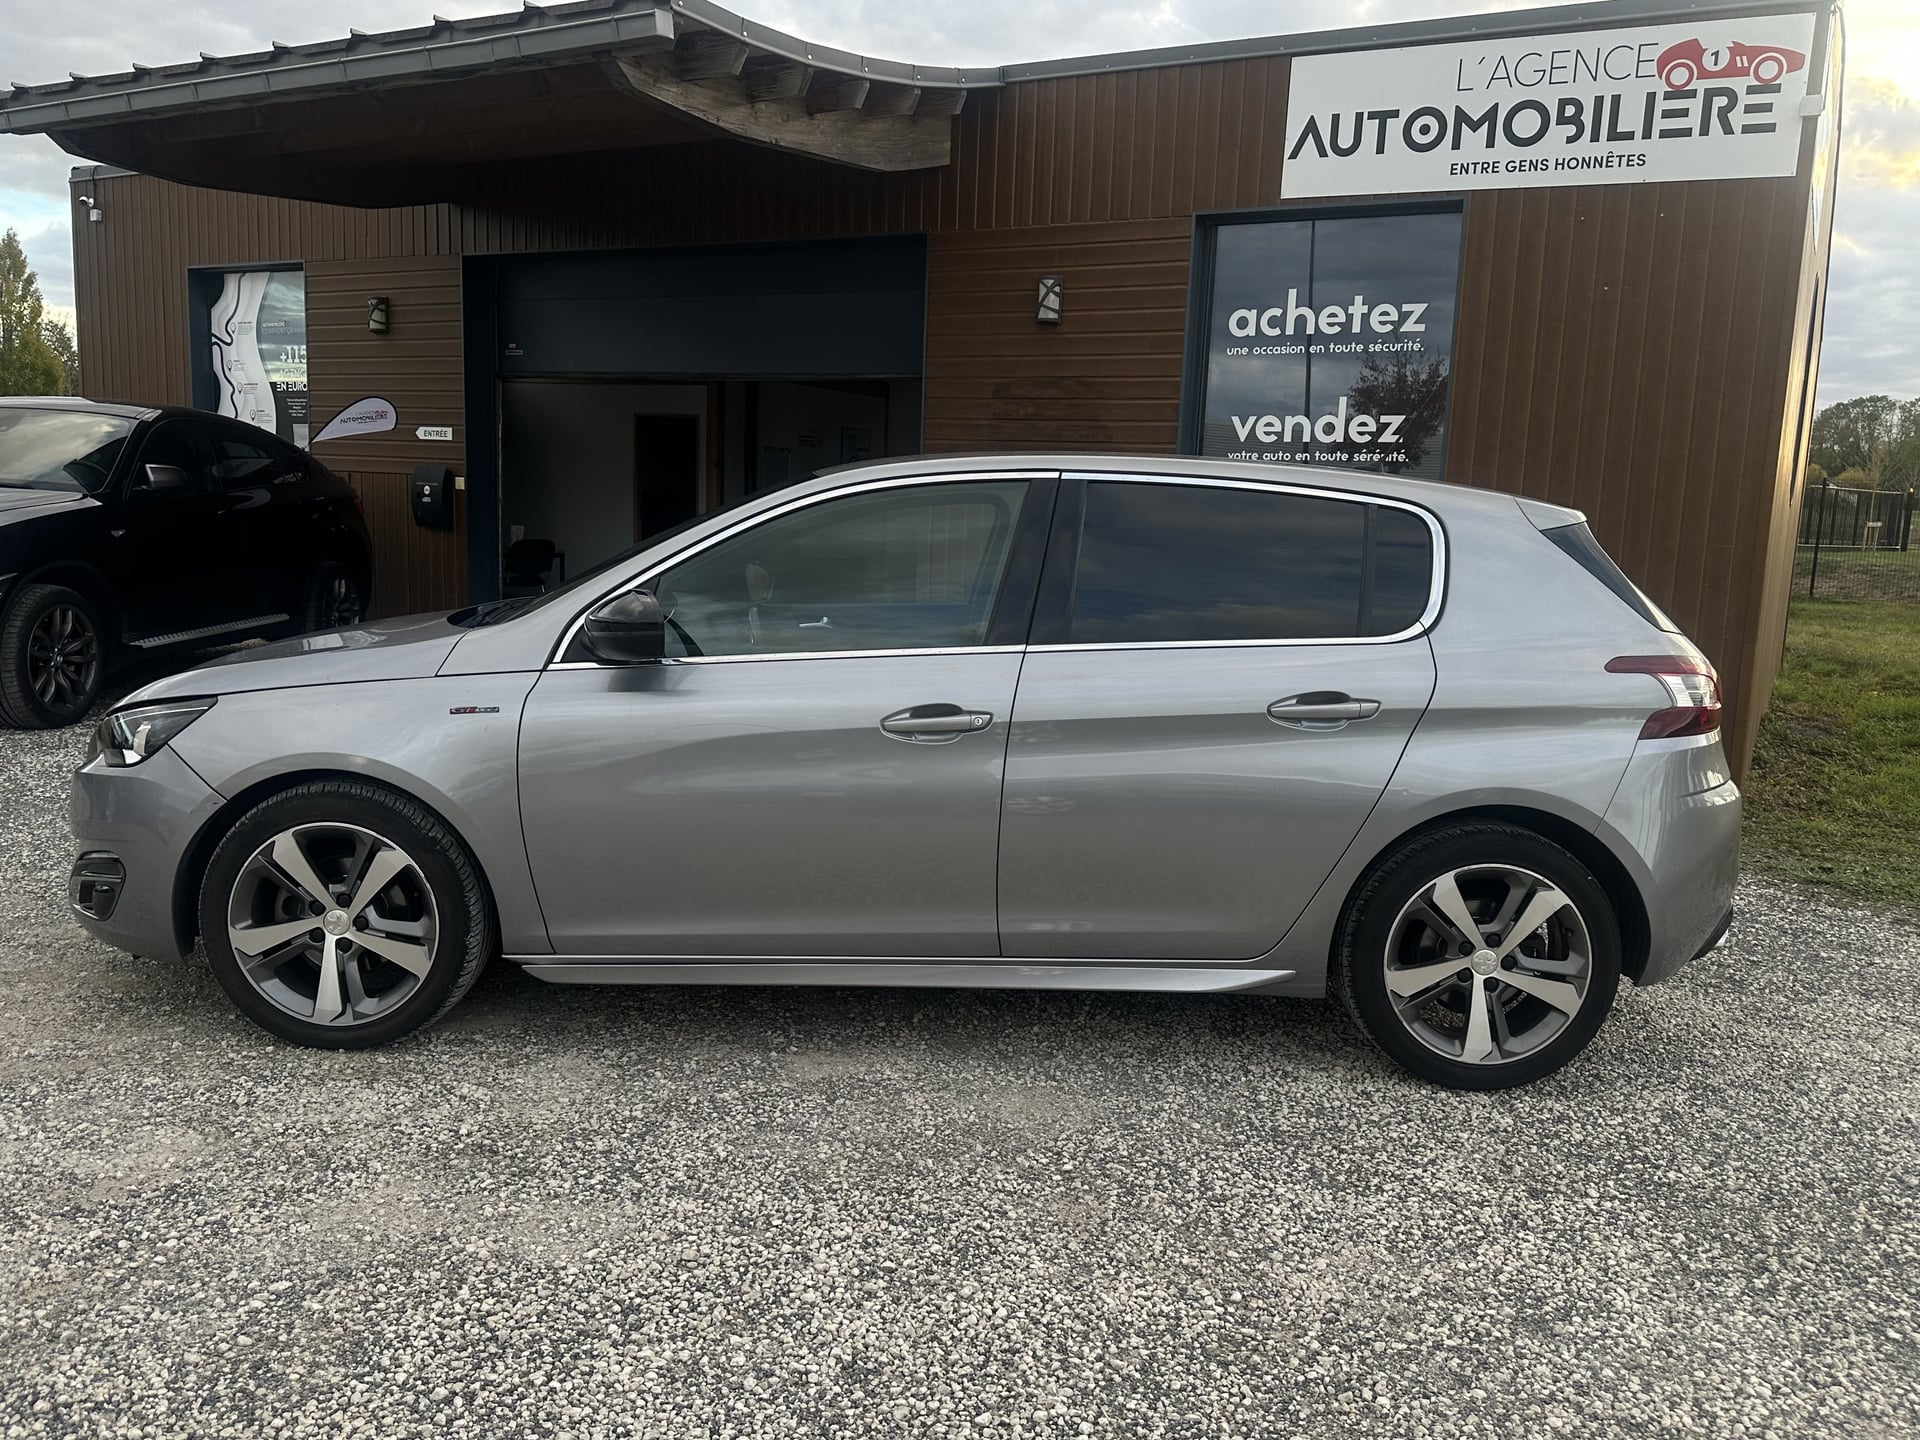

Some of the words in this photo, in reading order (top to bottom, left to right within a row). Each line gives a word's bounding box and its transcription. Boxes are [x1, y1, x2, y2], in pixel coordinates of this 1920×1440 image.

[1449, 161, 1500, 176] ENTRE
[1505, 158, 1549, 173] GENS
[1554, 151, 1646, 171] HONNÊTES
[1228, 288, 1429, 338] achetez
[1226, 346, 1249, 356] une
[1252, 342, 1305, 355] occasion
[1309, 344, 1325, 354] en
[1329, 342, 1364, 353] toute
[1368, 338, 1424, 352] sécurité.
[1231, 396, 1406, 443] vendez
[423, 428, 448, 438] ENTRÉE
[1228, 450, 1258, 460] votre
[1263, 450, 1291, 461] auto
[1295, 452, 1310, 461] en
[1315, 450, 1349, 461] toute
